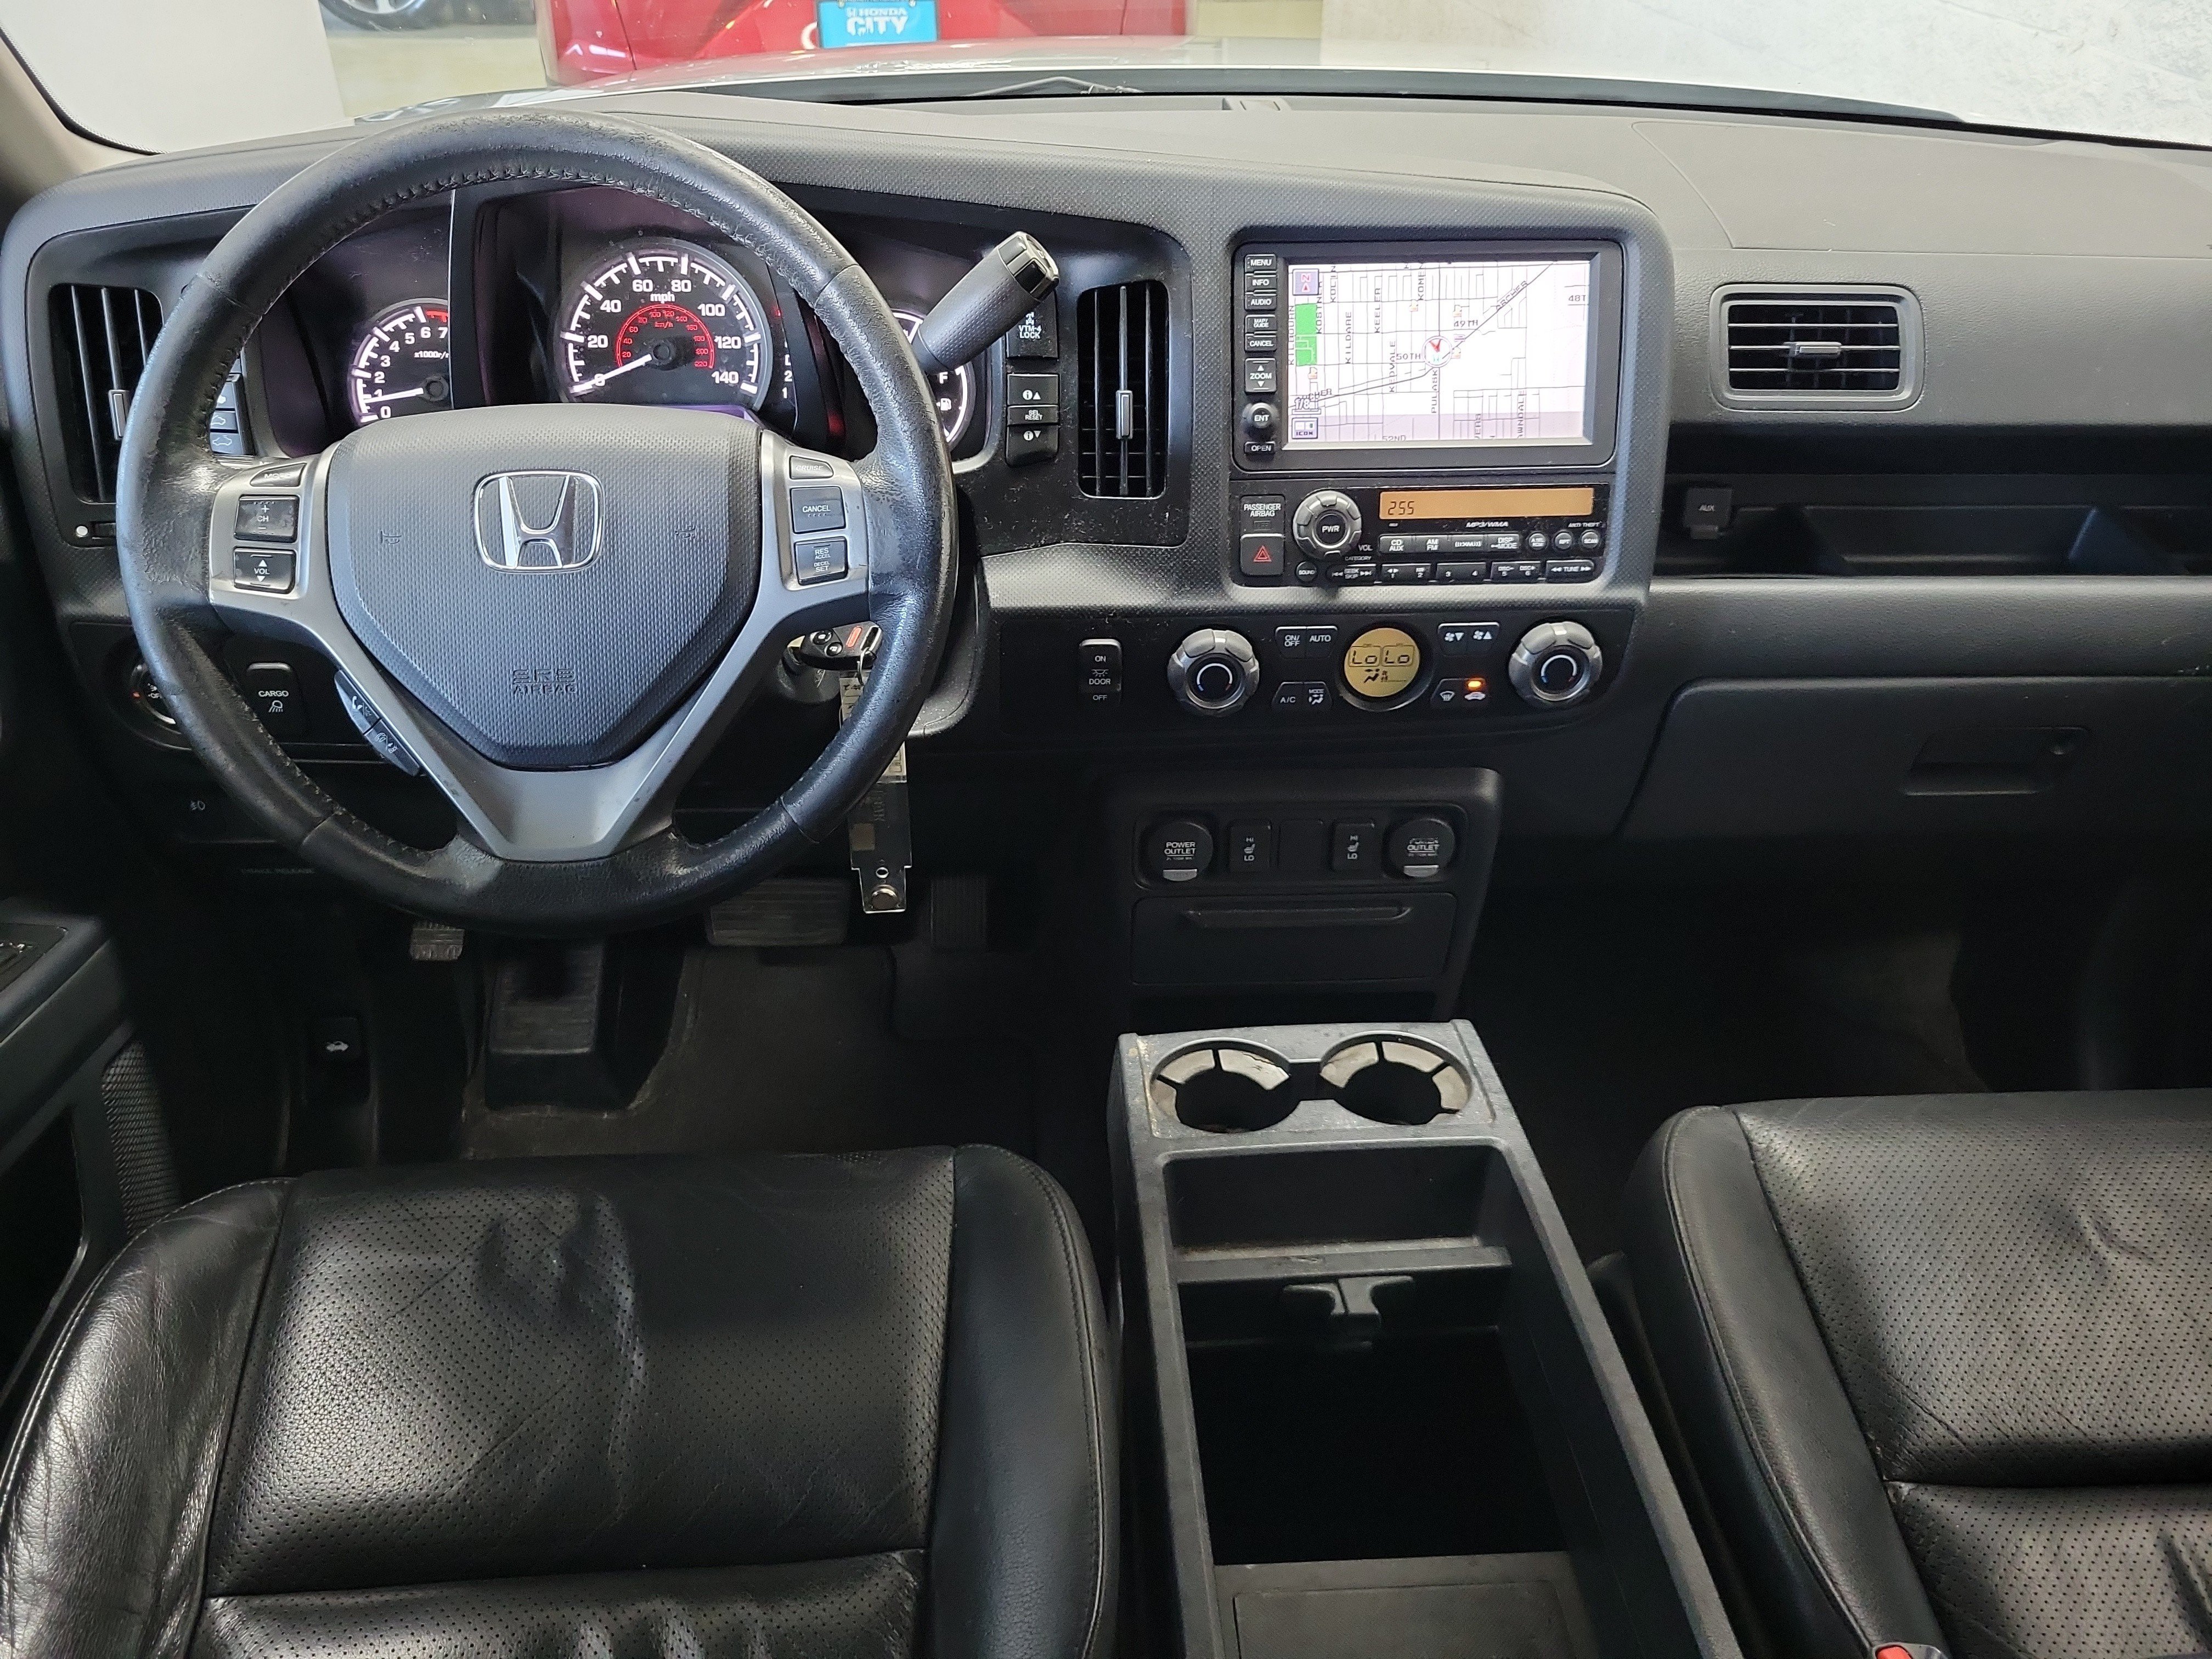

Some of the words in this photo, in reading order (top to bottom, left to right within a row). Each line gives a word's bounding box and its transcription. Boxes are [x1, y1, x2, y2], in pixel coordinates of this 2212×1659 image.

[857, 7, 908, 16] HONDA
[847, 16, 909, 36] CITY
[1301, 273, 1311, 282] N
[632, 279, 653, 292] 60
[671, 279, 692, 292] 80
[650, 292, 675, 303] mph
[600, 300, 622, 313] 40
[697, 303, 725, 316] 100
[654, 320, 674, 328] km/h
[1454, 319, 1478, 328] 49TH
[420, 326, 431, 338] 6
[438, 327, 448, 338] 7
[404, 332, 415, 345] 5
[588, 335, 608, 348] 20
[714, 336, 741, 349] 120
[389, 341, 400, 353] 4
[380, 355, 391, 367] 3
[374, 371, 385, 383] 2
[712, 371, 739, 383] 140
[785, 370, 793, 382] 2
[939, 372, 948, 383] F
[782, 386, 787, 399] 1
[380, 406, 391, 419] 0
[802, 505, 831, 513] CANCEL
[1387, 500, 1415, 515] 255
[512, 668, 575, 683] SRS
[512, 684, 577, 695] AIRBAG
